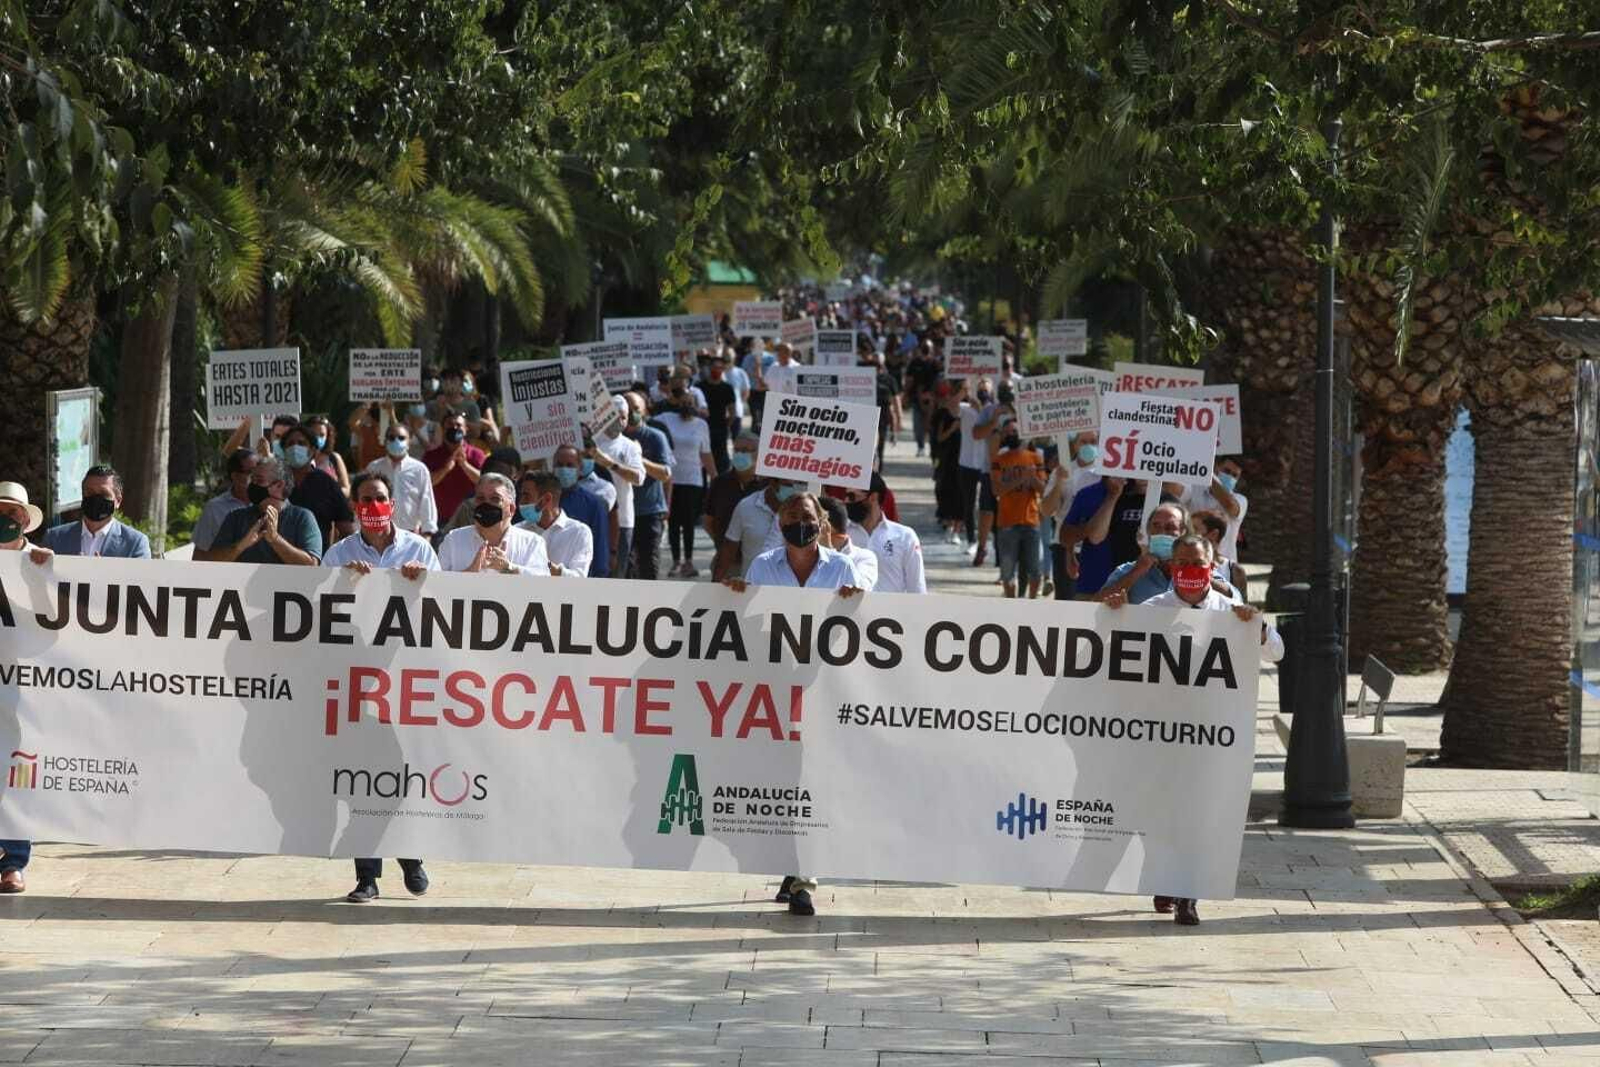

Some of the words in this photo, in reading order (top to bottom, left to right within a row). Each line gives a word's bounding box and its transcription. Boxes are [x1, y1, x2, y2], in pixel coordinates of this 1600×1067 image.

[353, 352, 367, 360] NO
[212, 362, 247, 381] ERTES
[249, 360, 297, 379] TOTALES
[1018, 381, 1032, 391] La
[1034, 375, 1095, 390] hostelería
[213, 384, 260, 406] HASTA
[264, 382, 299, 404] 2021
[779, 399, 807, 419] Sin
[809, 405, 848, 424] ocio
[1027, 404, 1039, 413] La
[1046, 410, 1072, 422] parte
[1075, 407, 1087, 416] de
[1141, 401, 1178, 415] Fiestas
[1042, 416, 1092, 430] solución
[1108, 409, 1178, 426] clandestinas
[1175, 405, 1214, 432] NO
[520, 430, 576, 451] científica
[774, 419, 860, 446] nocturno,
[769, 432, 816, 454] más
[1102, 430, 1141, 471] SÍ
[1142, 441, 1176, 458] Ocio
[764, 453, 862, 479] contagios
[1140, 459, 1208, 477] regulado
[35, 582, 252, 642] JUNTA
[273, 592, 357, 645] DE
[769, 613, 904, 670] NOS
[924, 620, 1238, 690] CONDENA
[324, 666, 675, 736] ¡RESCATE
[696, 680, 804, 742] YA!
[837, 703, 1236, 748] #SALVEMOSELOCIONOCTURNO
[44, 755, 139, 776] HOSTELERÍA
[43, 776, 62, 791] DE
[69, 776, 129, 794] ESPAÑA
[713, 786, 812, 801] ANDALUCÍA
[713, 802, 735, 814] DE
[746, 803, 812, 818] NOCHE
[1056, 799, 1114, 813] ESPAÑA
[1055, 813, 1071, 822] DE
[1073, 814, 1114, 826] NOCHE
